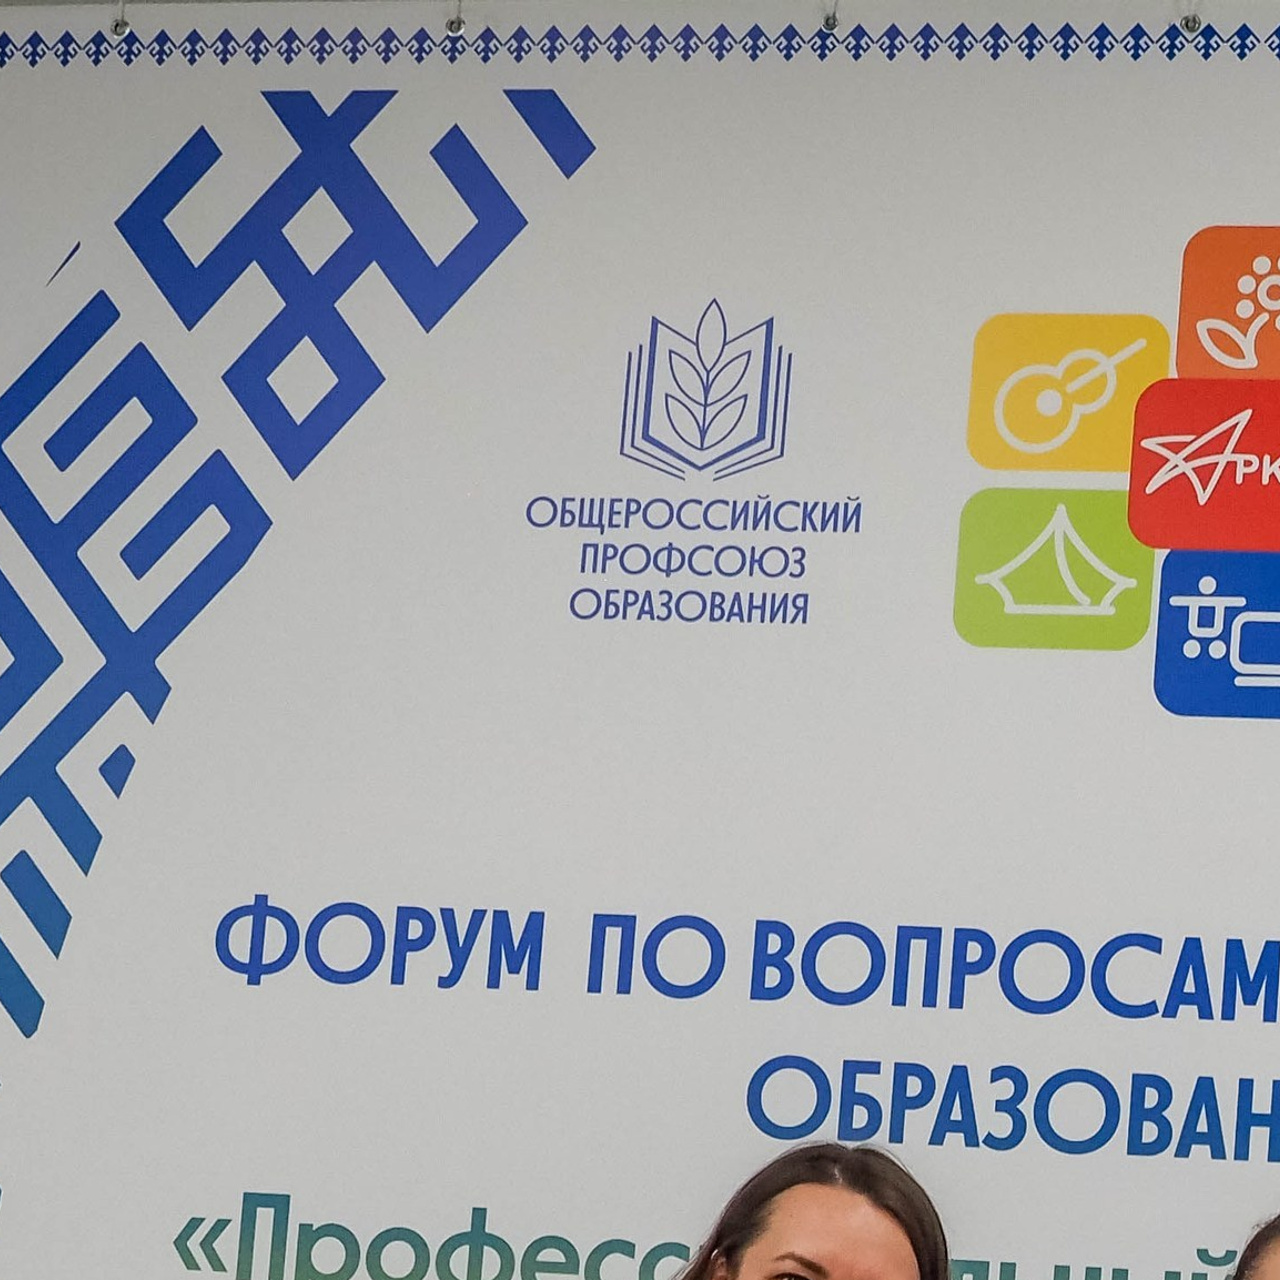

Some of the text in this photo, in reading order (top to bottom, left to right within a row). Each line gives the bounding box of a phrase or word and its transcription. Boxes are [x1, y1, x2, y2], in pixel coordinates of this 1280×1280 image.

[526, 494, 862, 535] ОБЩЕРОССИЙСКИЙ
[580, 542, 806, 578] ПРОФСОЮЗ
[569, 588, 809, 624] ОБРАЗОВАНИЯ
[215, 893, 545, 991] ФОРУМ
[586, 913, 725, 999] ПО
[749, 919, 1280, 1025] ВОПРОСАМ
